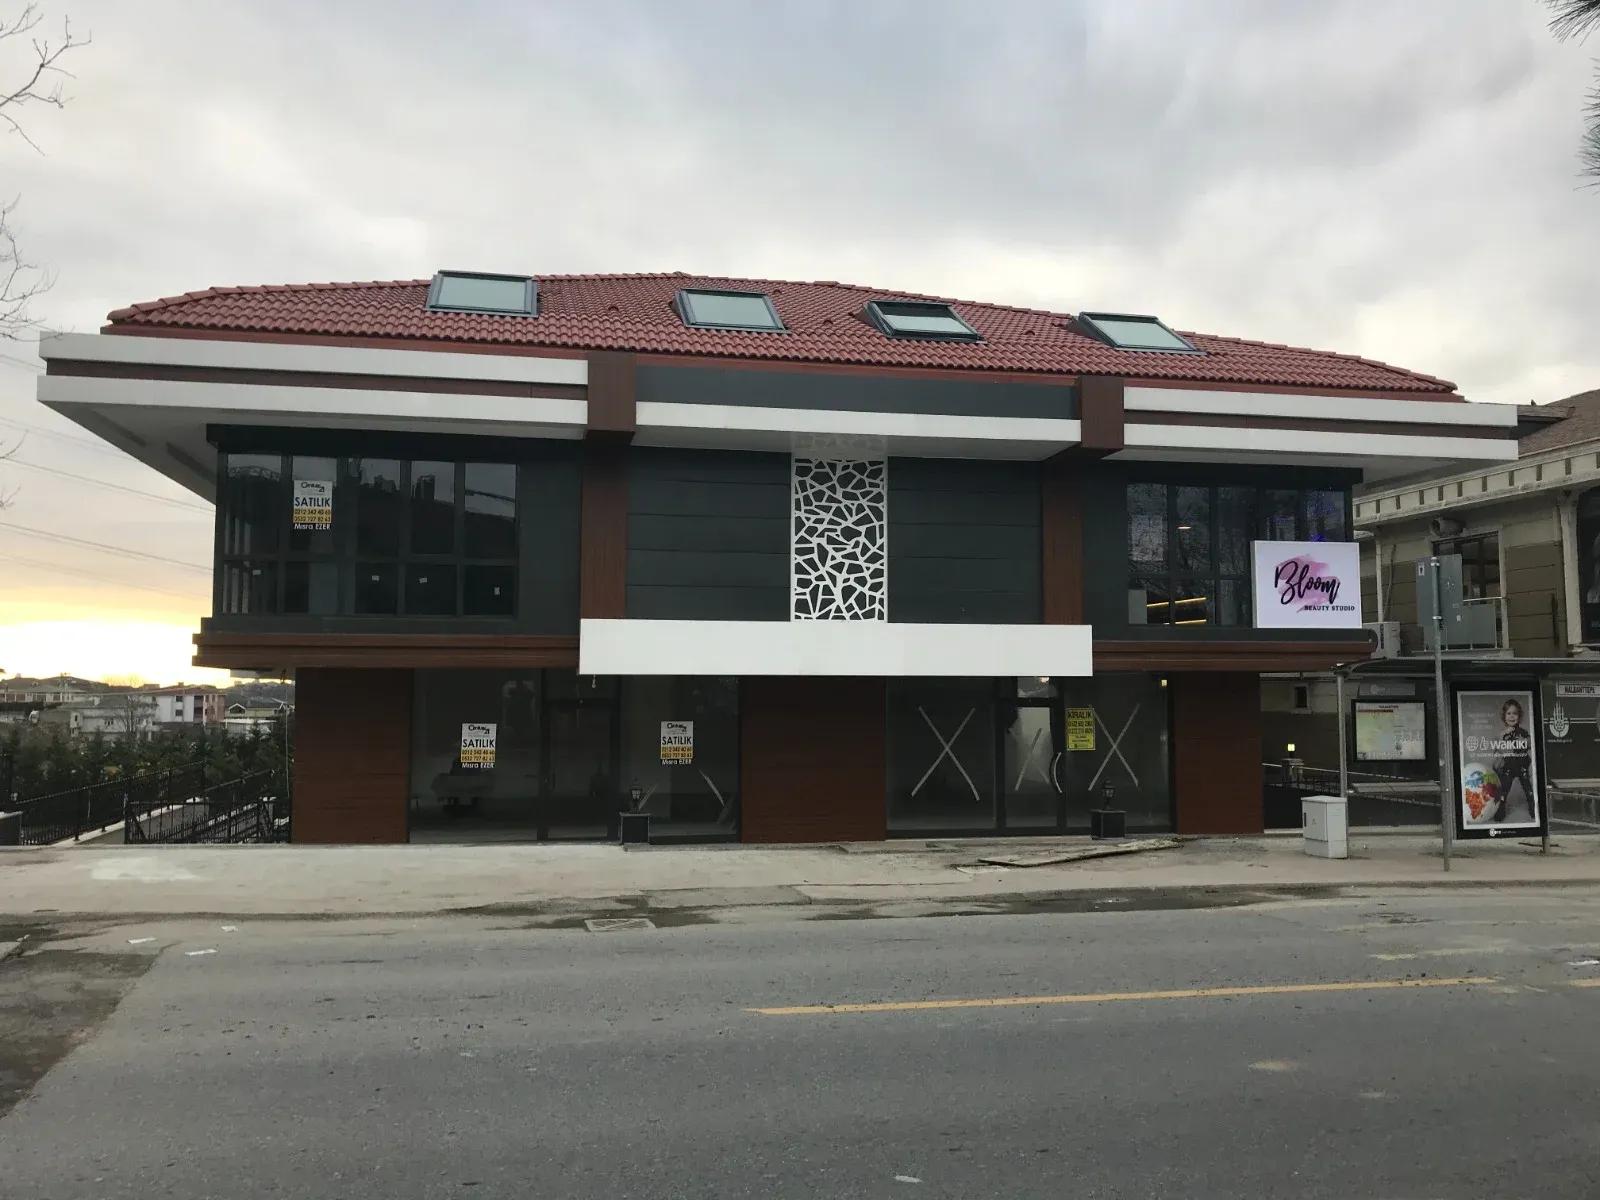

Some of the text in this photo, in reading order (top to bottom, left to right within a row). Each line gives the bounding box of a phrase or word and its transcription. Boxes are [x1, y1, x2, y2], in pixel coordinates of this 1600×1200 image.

[295, 497, 331, 507] SATILIK
[1274, 560, 1341, 605] Bloom
[463, 739, 495, 748] SATILIK
[662, 736, 692, 746] SATILIK
